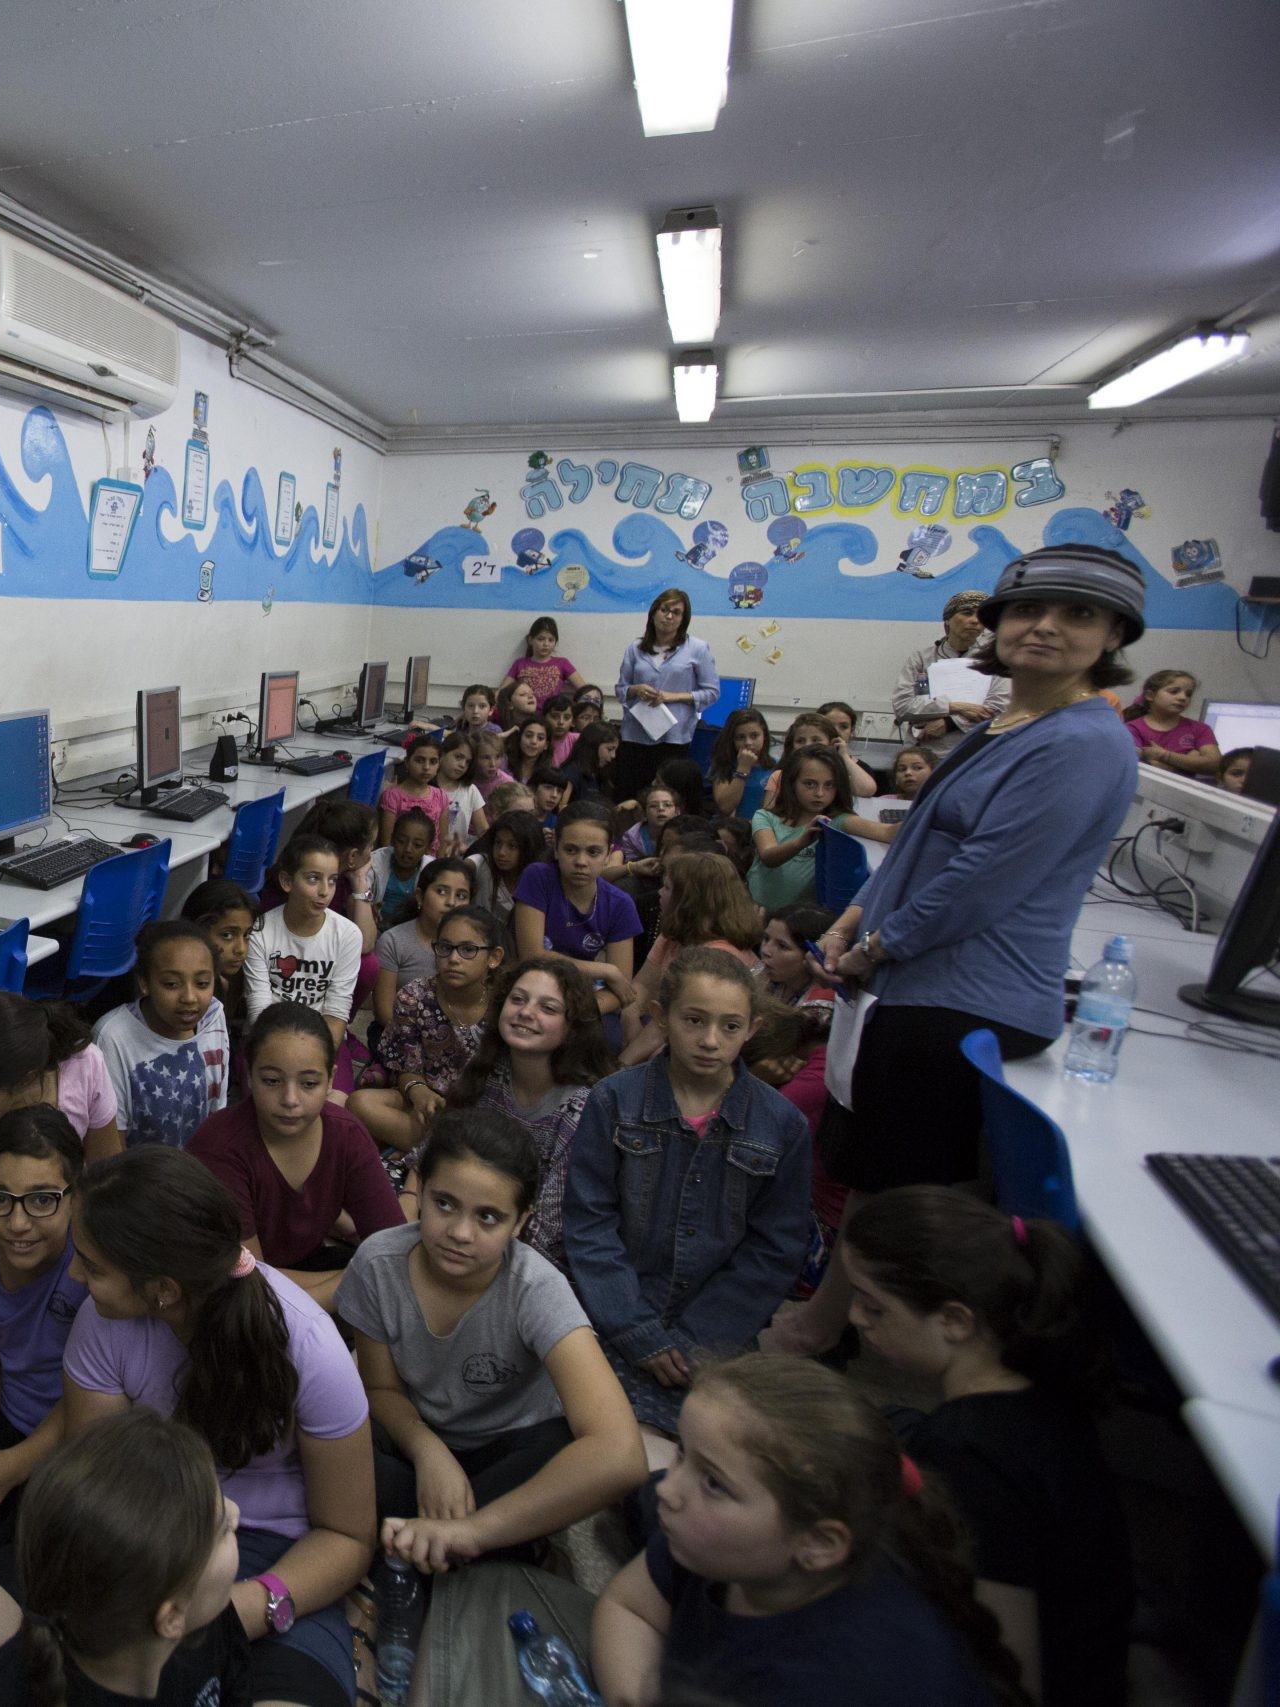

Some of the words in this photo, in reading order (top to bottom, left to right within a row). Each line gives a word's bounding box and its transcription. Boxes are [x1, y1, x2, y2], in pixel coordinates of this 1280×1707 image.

[519, 458, 712, 520] תחילה
[741, 457, 1066, 523] במחשבה
[282, 977, 331, 993] grea
[296, 960, 334, 979] my
